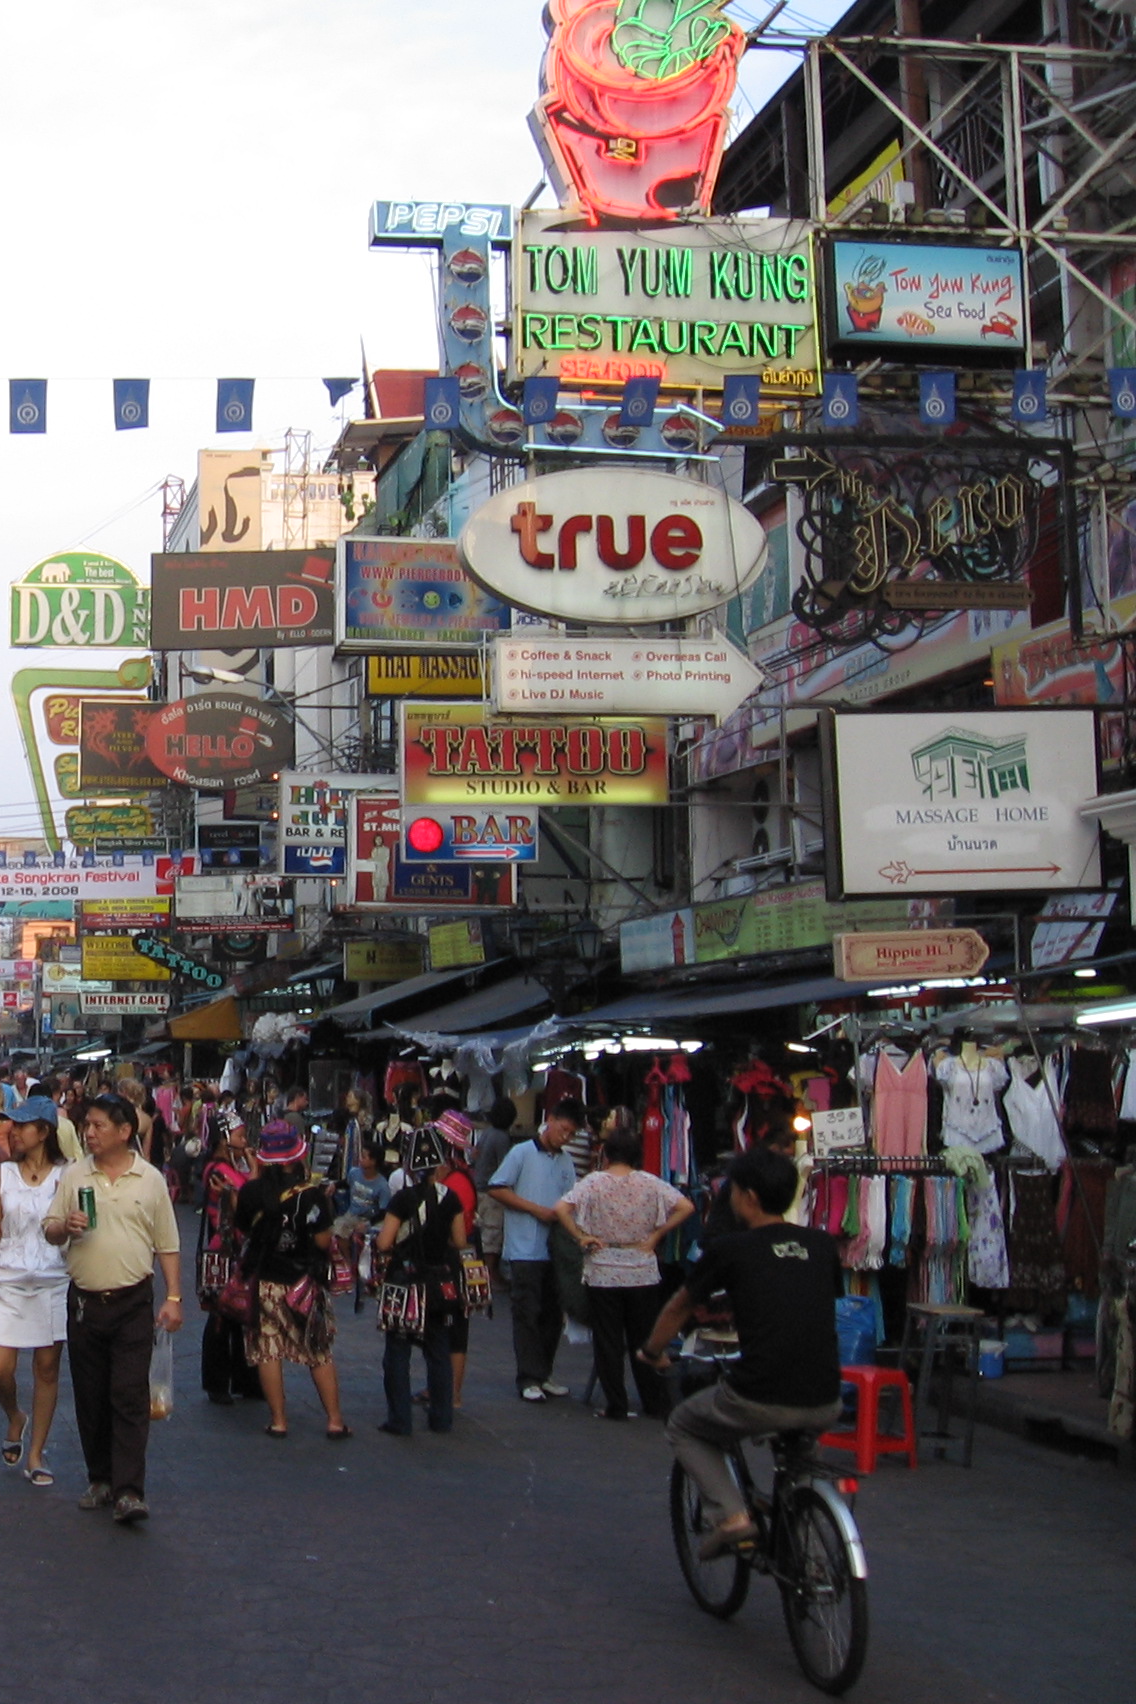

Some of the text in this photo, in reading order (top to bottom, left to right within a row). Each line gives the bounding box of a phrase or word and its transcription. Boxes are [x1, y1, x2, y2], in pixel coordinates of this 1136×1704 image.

[385, 202, 503, 237] PEPSI
[523, 245, 809, 302] TOM YUM KUNG
[970, 274, 1016, 306] Kung
[924, 302, 952, 319] Sea
[523, 314, 806, 358] RESTAURANT
[511, 502, 704, 570] true
[180, 584, 318, 631] HMD
[15, 588, 126, 645] D&D
[521, 650, 611, 661] Coffee & Snack
[646, 652, 727, 662] Overseas Call
[521, 670, 624, 682] hi-speed Internet
[647, 671, 731, 684] Photo Printing
[522, 690, 604, 699] Live DJ Music
[166, 733, 254, 758] HELLO
[420, 725, 646, 775] TATTOO
[234, 769, 261, 787] road
[466, 780, 607, 795] STUDIO & BAR
[896, 807, 1049, 824] MASSAGE HOME
[286, 828, 310, 837] BAR
[316, 828, 324, 837] &
[450, 815, 534, 845] BAR
[947, 834, 998, 851] บ้านนวด
[15, 872, 81, 886] Songkran
[85, 871, 139, 883] Festival
[42, 886, 79, 896] 2008
[876, 947, 922, 961] Hippie
[138, 939, 222, 988] TATTOO
[85, 995, 166, 1005] INTERNET CAFE
